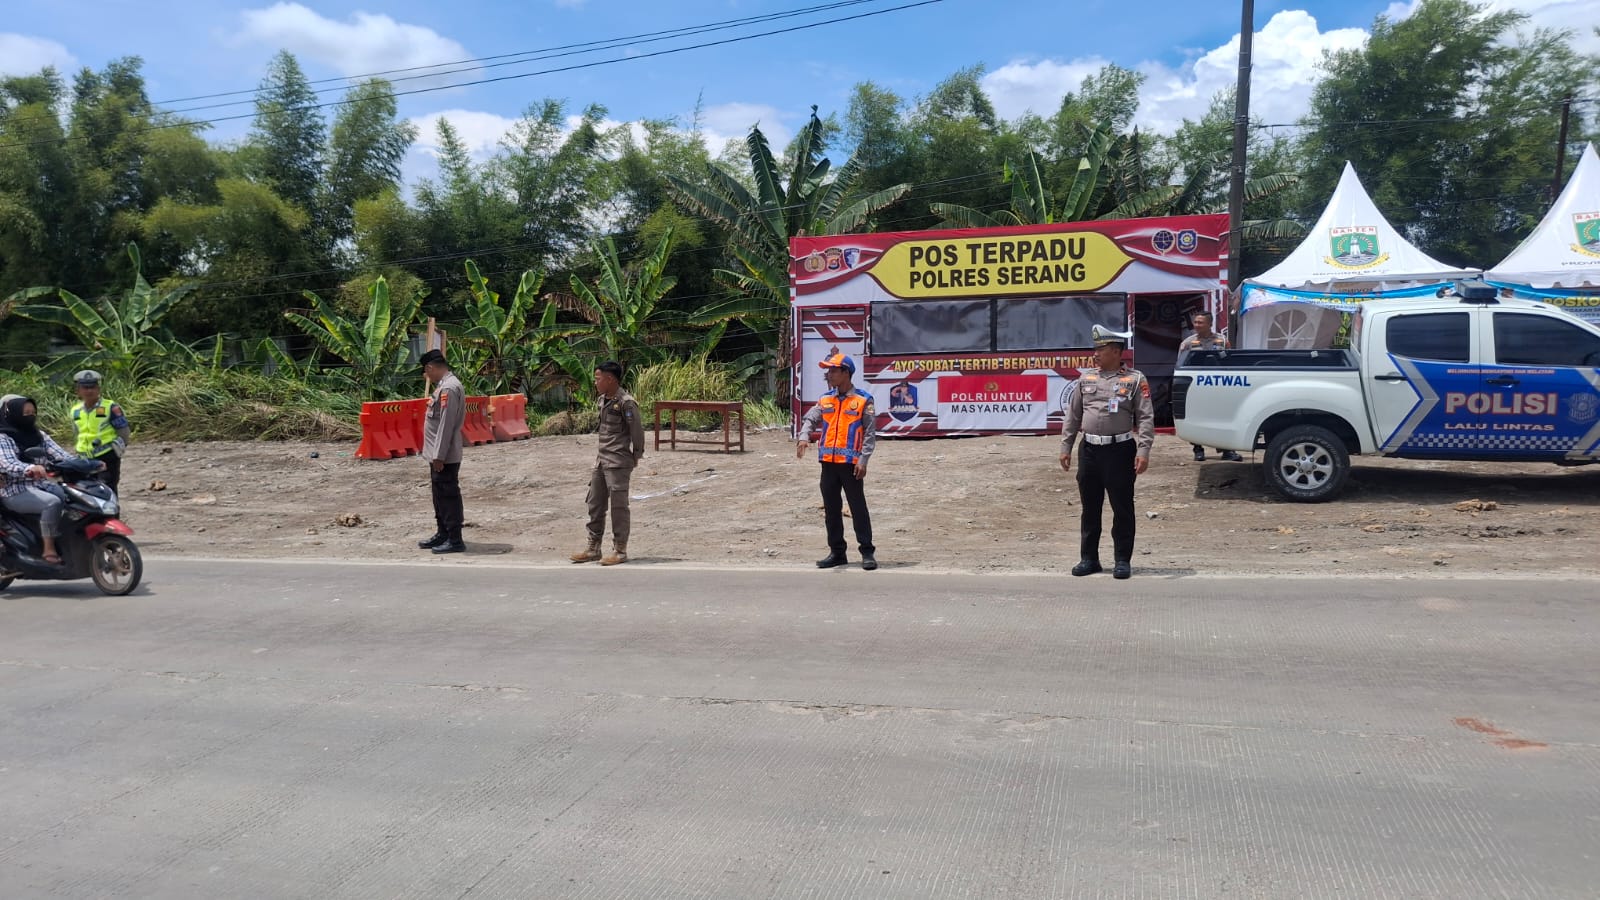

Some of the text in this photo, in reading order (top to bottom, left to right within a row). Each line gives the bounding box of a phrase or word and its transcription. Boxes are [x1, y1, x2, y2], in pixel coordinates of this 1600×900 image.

[910, 238, 1086, 268] POS TERPADU
[910, 263, 1086, 289] POLRES SERANG
[894, 356, 1098, 372] AYO SOBAT TERTIB BERLALU LINTA
[1196, 375, 1251, 387] PATWAL
[951, 392, 1033, 402] POLRI UNTUK
[1445, 392, 1558, 416] POLISI
[951, 404, 1033, 413] MASYARAKAT
[1492, 423, 1555, 431] LINTAS
